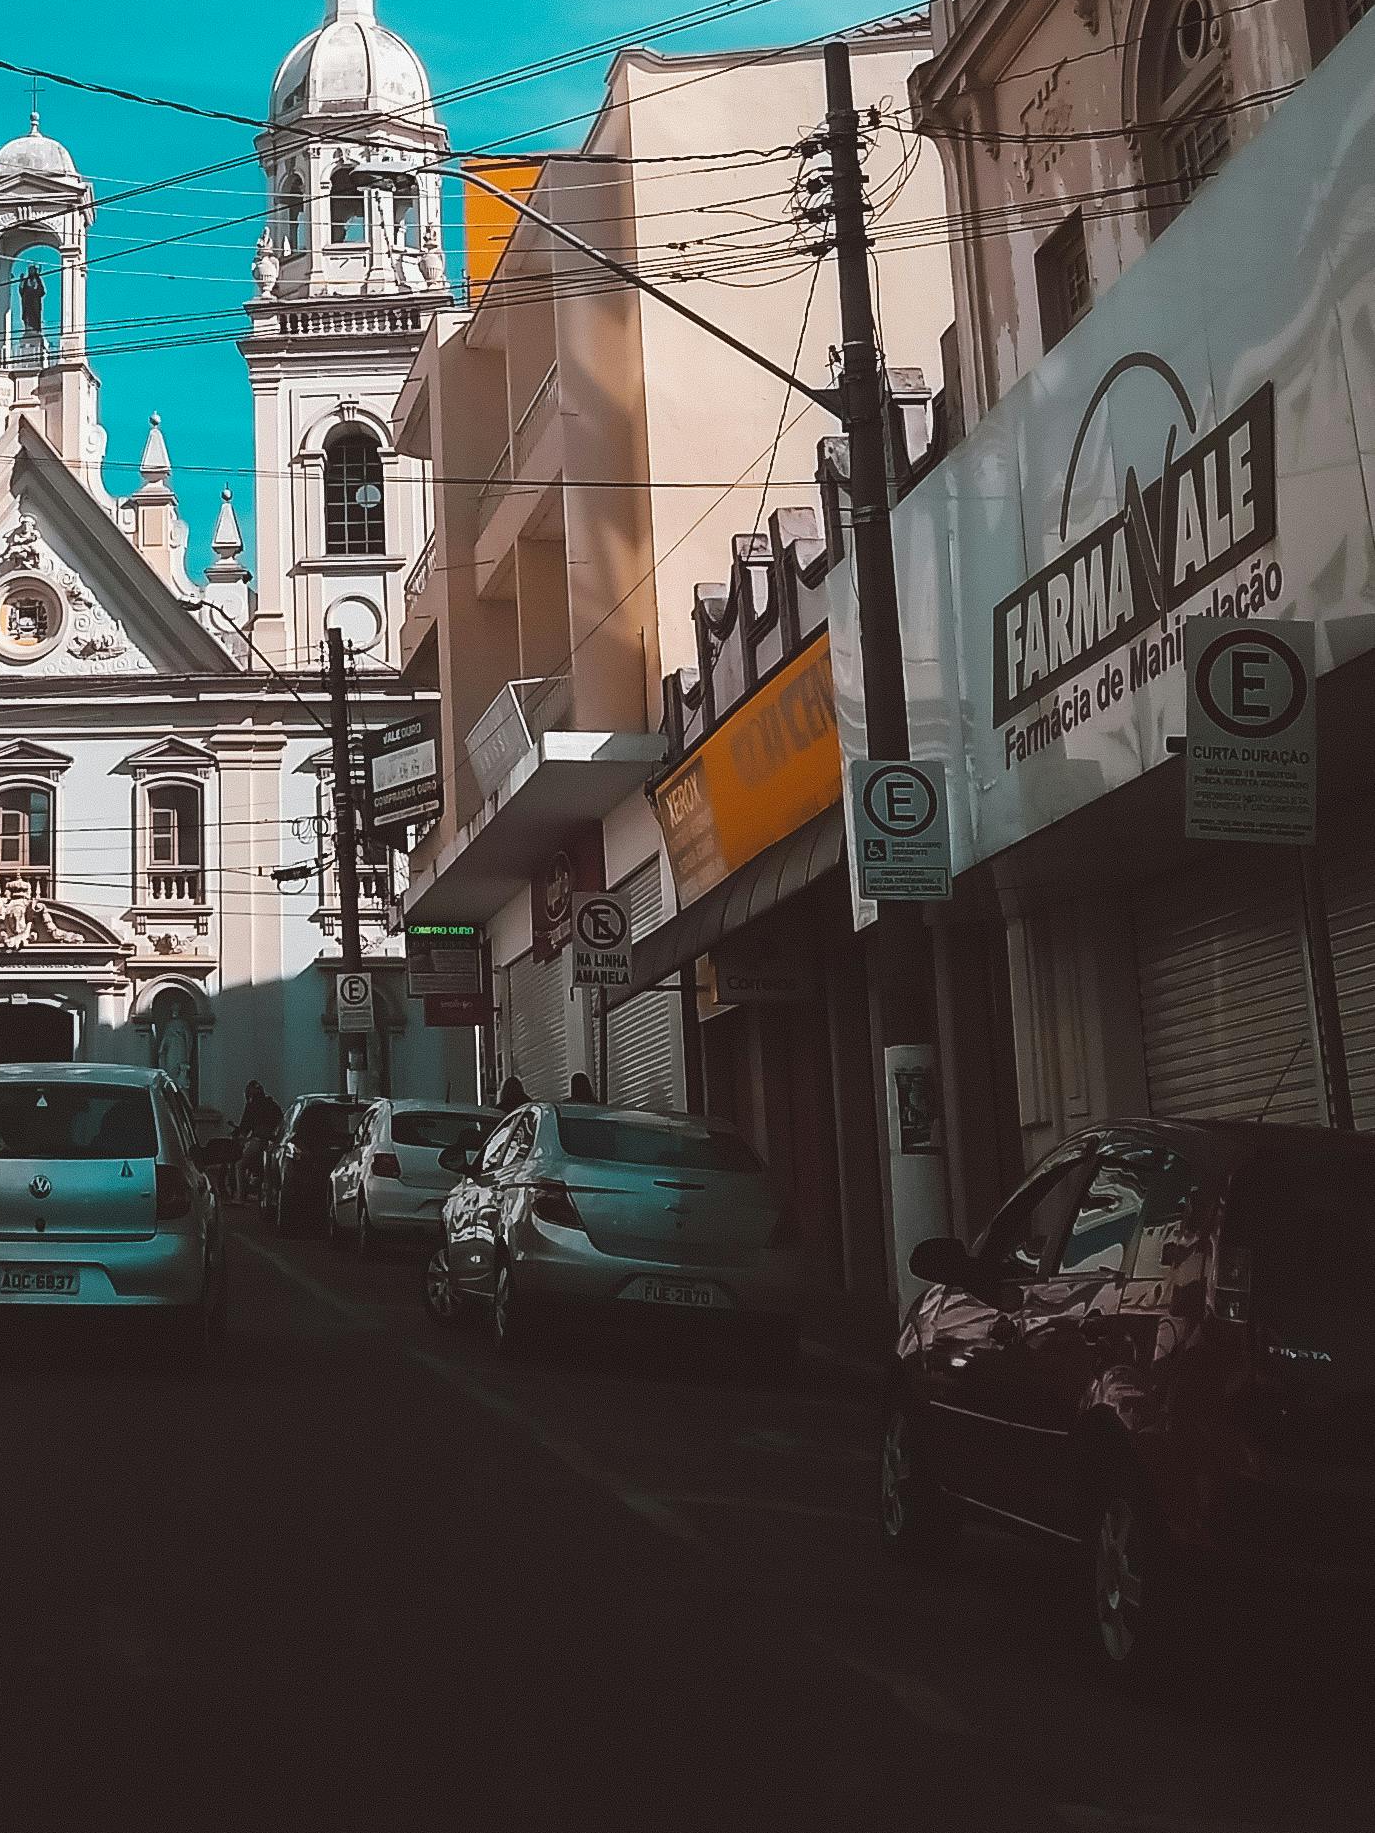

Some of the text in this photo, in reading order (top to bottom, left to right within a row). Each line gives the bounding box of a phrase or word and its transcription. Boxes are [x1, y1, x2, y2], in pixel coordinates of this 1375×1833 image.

[1004, 559, 1283, 771] Farmácia de Manilação
[1231, 651, 1270, 718] E
[1193, 746, 1240, 761] CURTA
[665, 771, 704, 829] XEROX
[885, 781, 917, 822] E
[408, 926, 475, 935] COMPRO OURO
[576, 952, 629, 969] NA LINHA
[575, 970, 630, 985] AMARELA
[349, 980, 361, 1000] E
